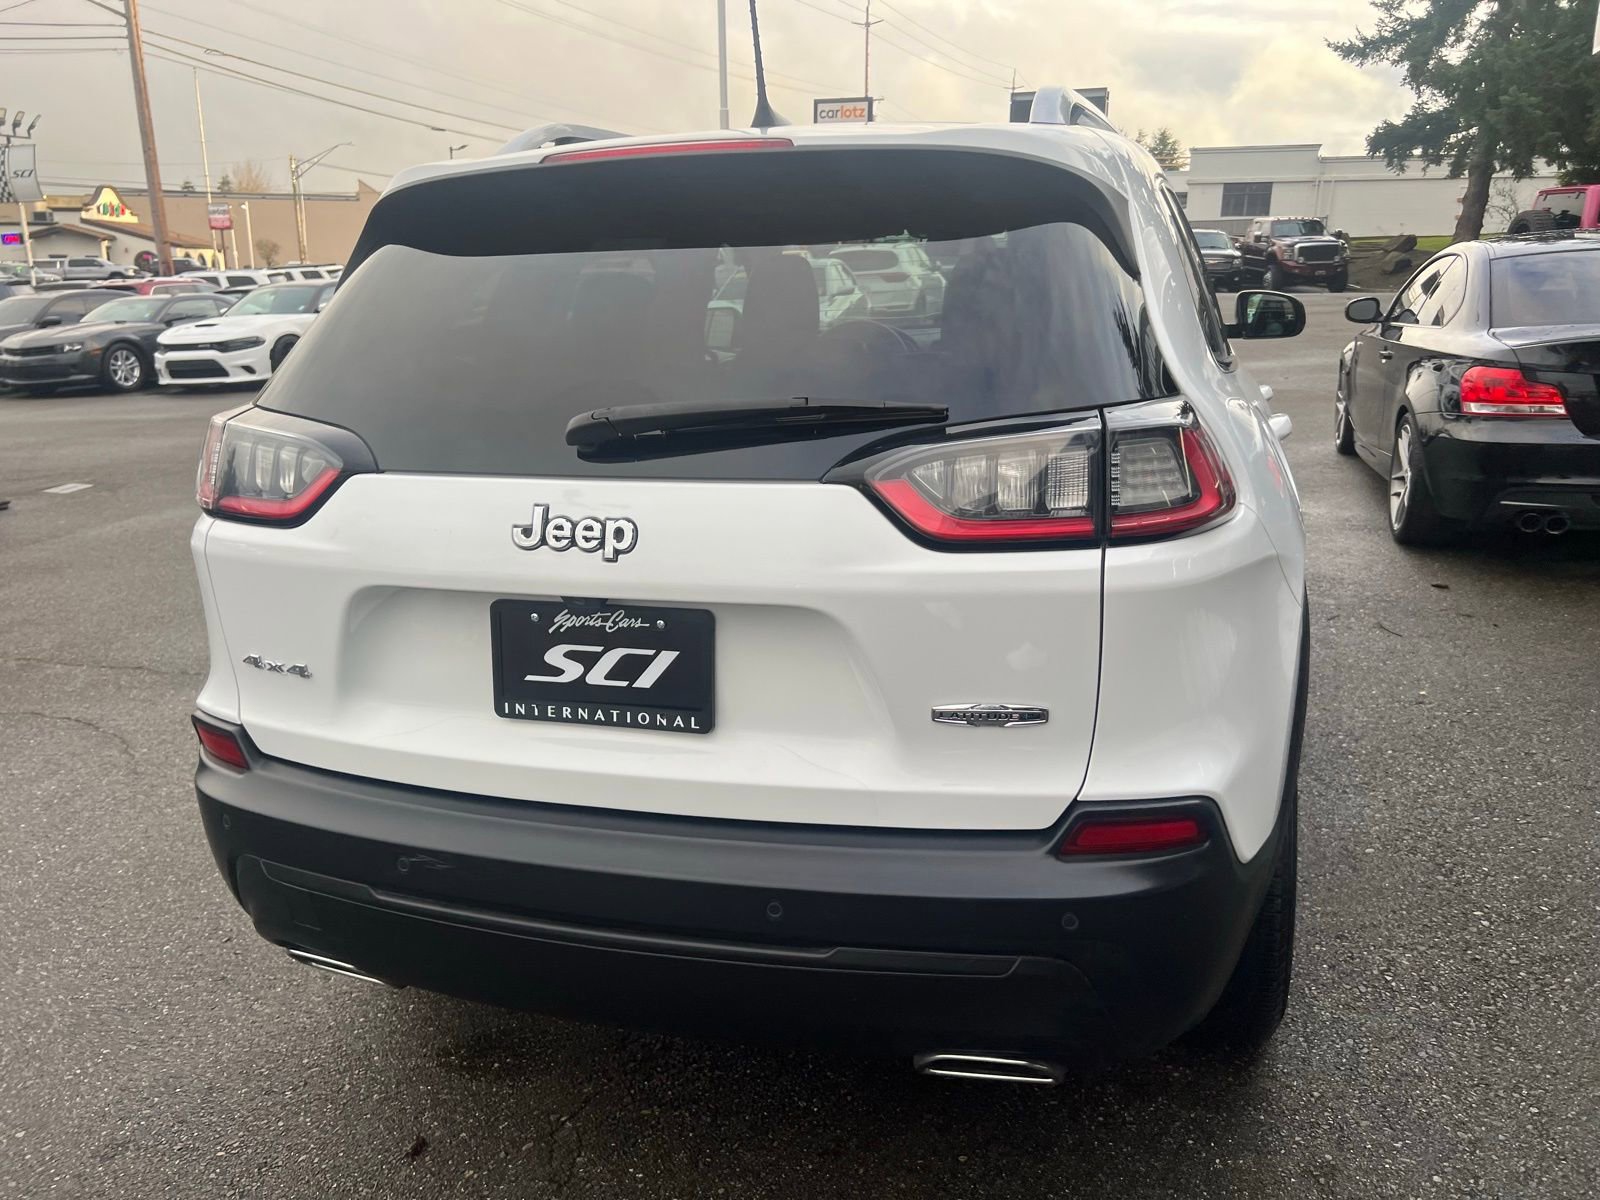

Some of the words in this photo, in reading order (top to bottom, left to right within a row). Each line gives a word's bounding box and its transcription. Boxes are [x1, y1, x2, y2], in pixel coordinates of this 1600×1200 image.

[819, 105, 866, 119] carlotz
[12, 168, 34, 179] SCI
[511, 503, 639, 563] Jeep
[548, 609, 606, 634] Sports
[605, 609, 650, 633] Cars
[242, 653, 313, 680] 4x4
[523, 643, 681, 690] SCI
[503, 701, 701, 730] INTERNATIONAL
[938, 711, 1020, 721] LATITUDE
